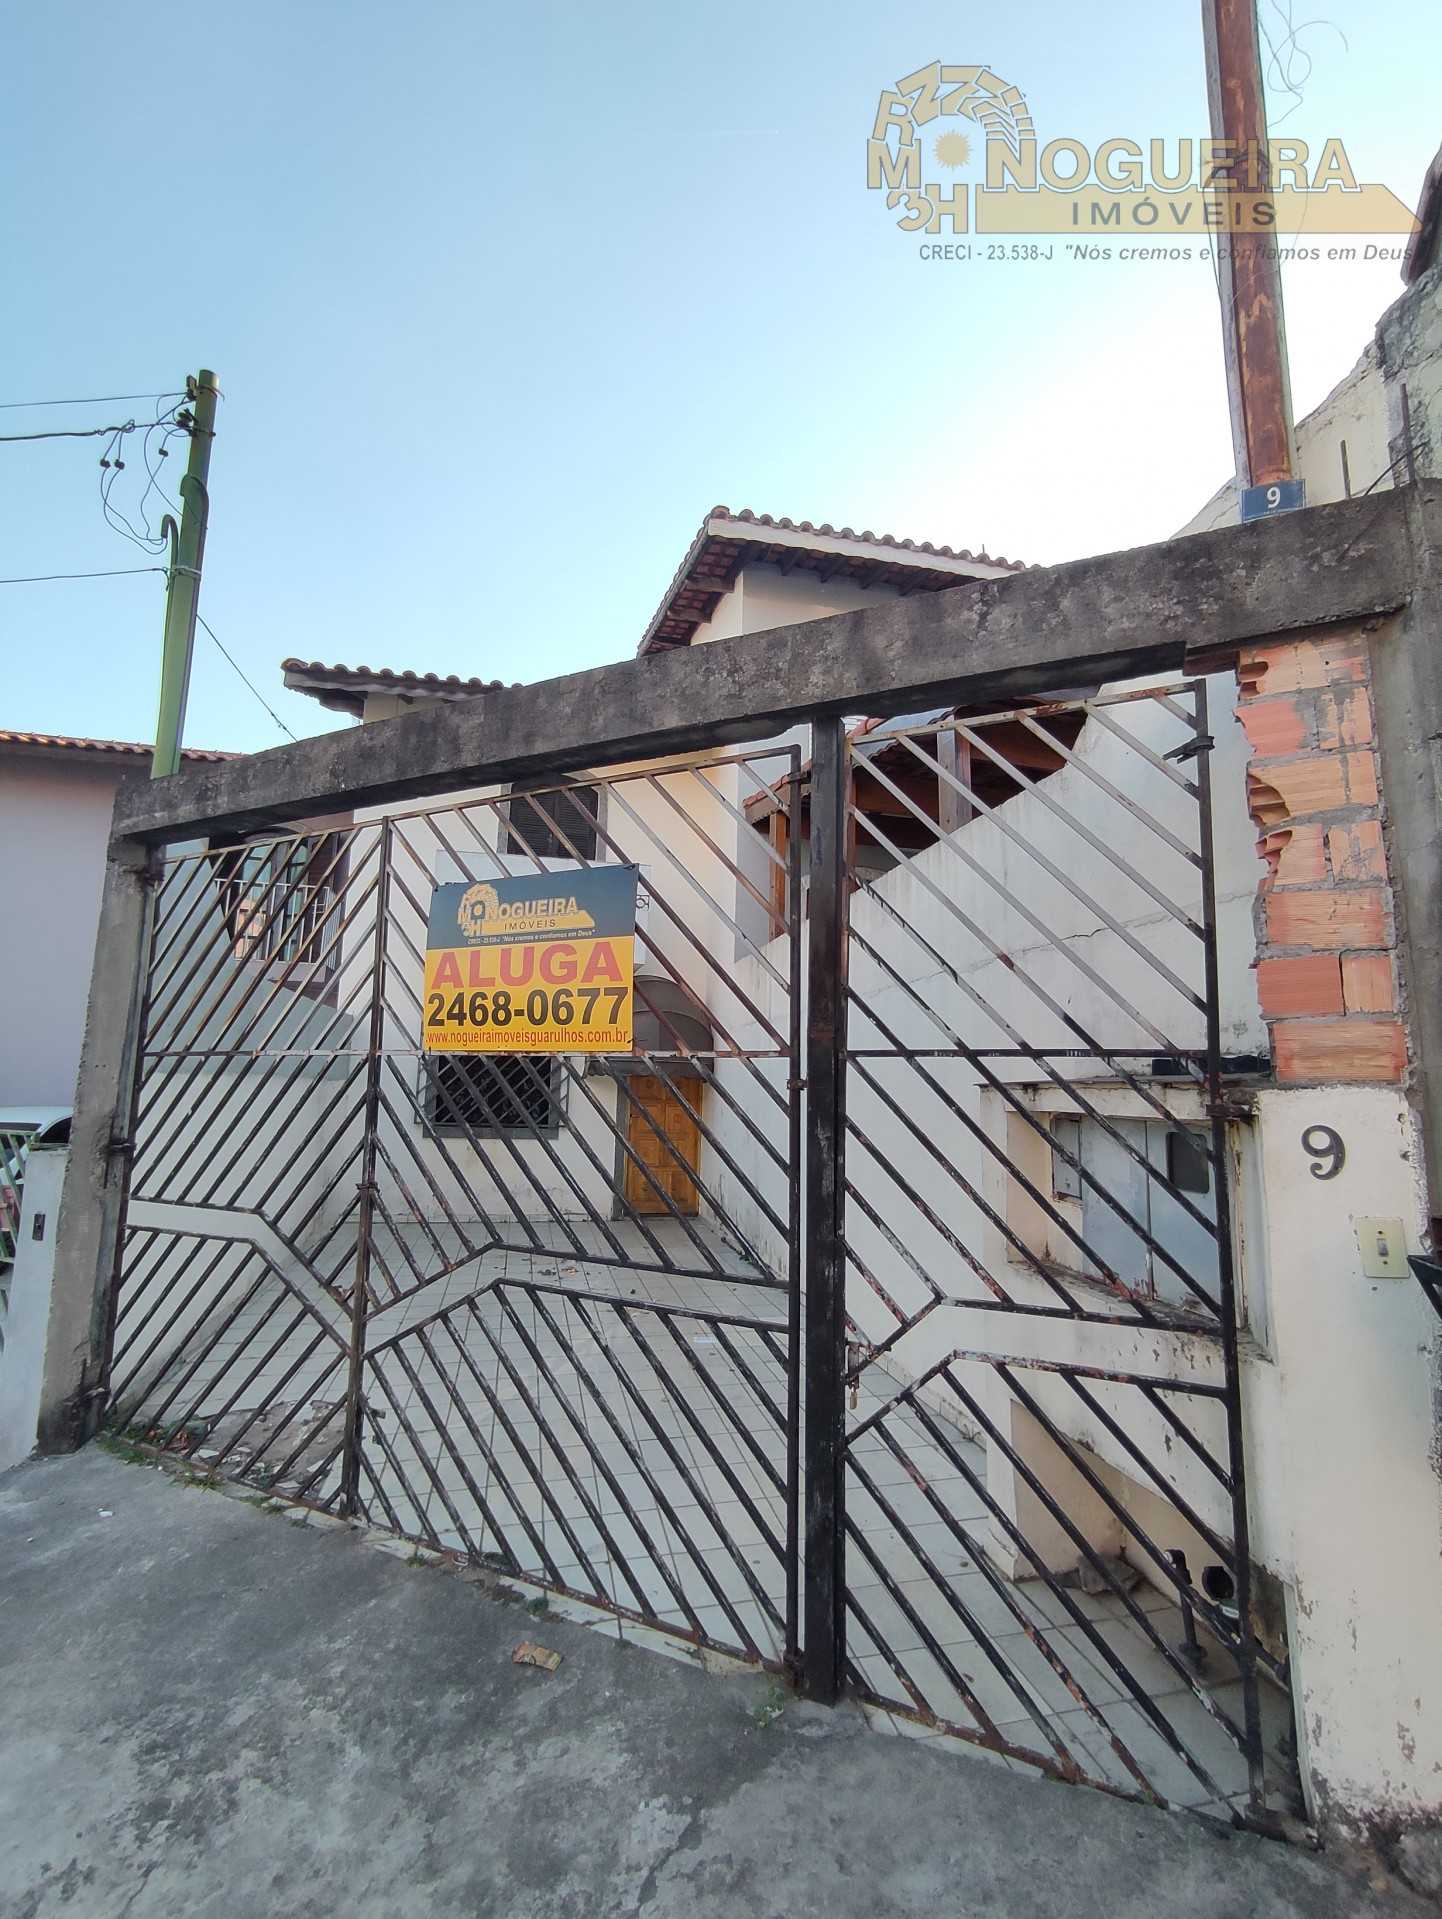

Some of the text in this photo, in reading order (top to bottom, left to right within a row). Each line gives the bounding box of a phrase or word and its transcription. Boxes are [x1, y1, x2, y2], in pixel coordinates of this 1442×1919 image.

[1266, 486, 1281, 509] 9
[486, 897, 578, 921] NOGUEIRA
[431, 941, 624, 989] ALUGA
[428, 987, 629, 1026] 2468-0677
[1301, 1125, 1345, 1180] 9
